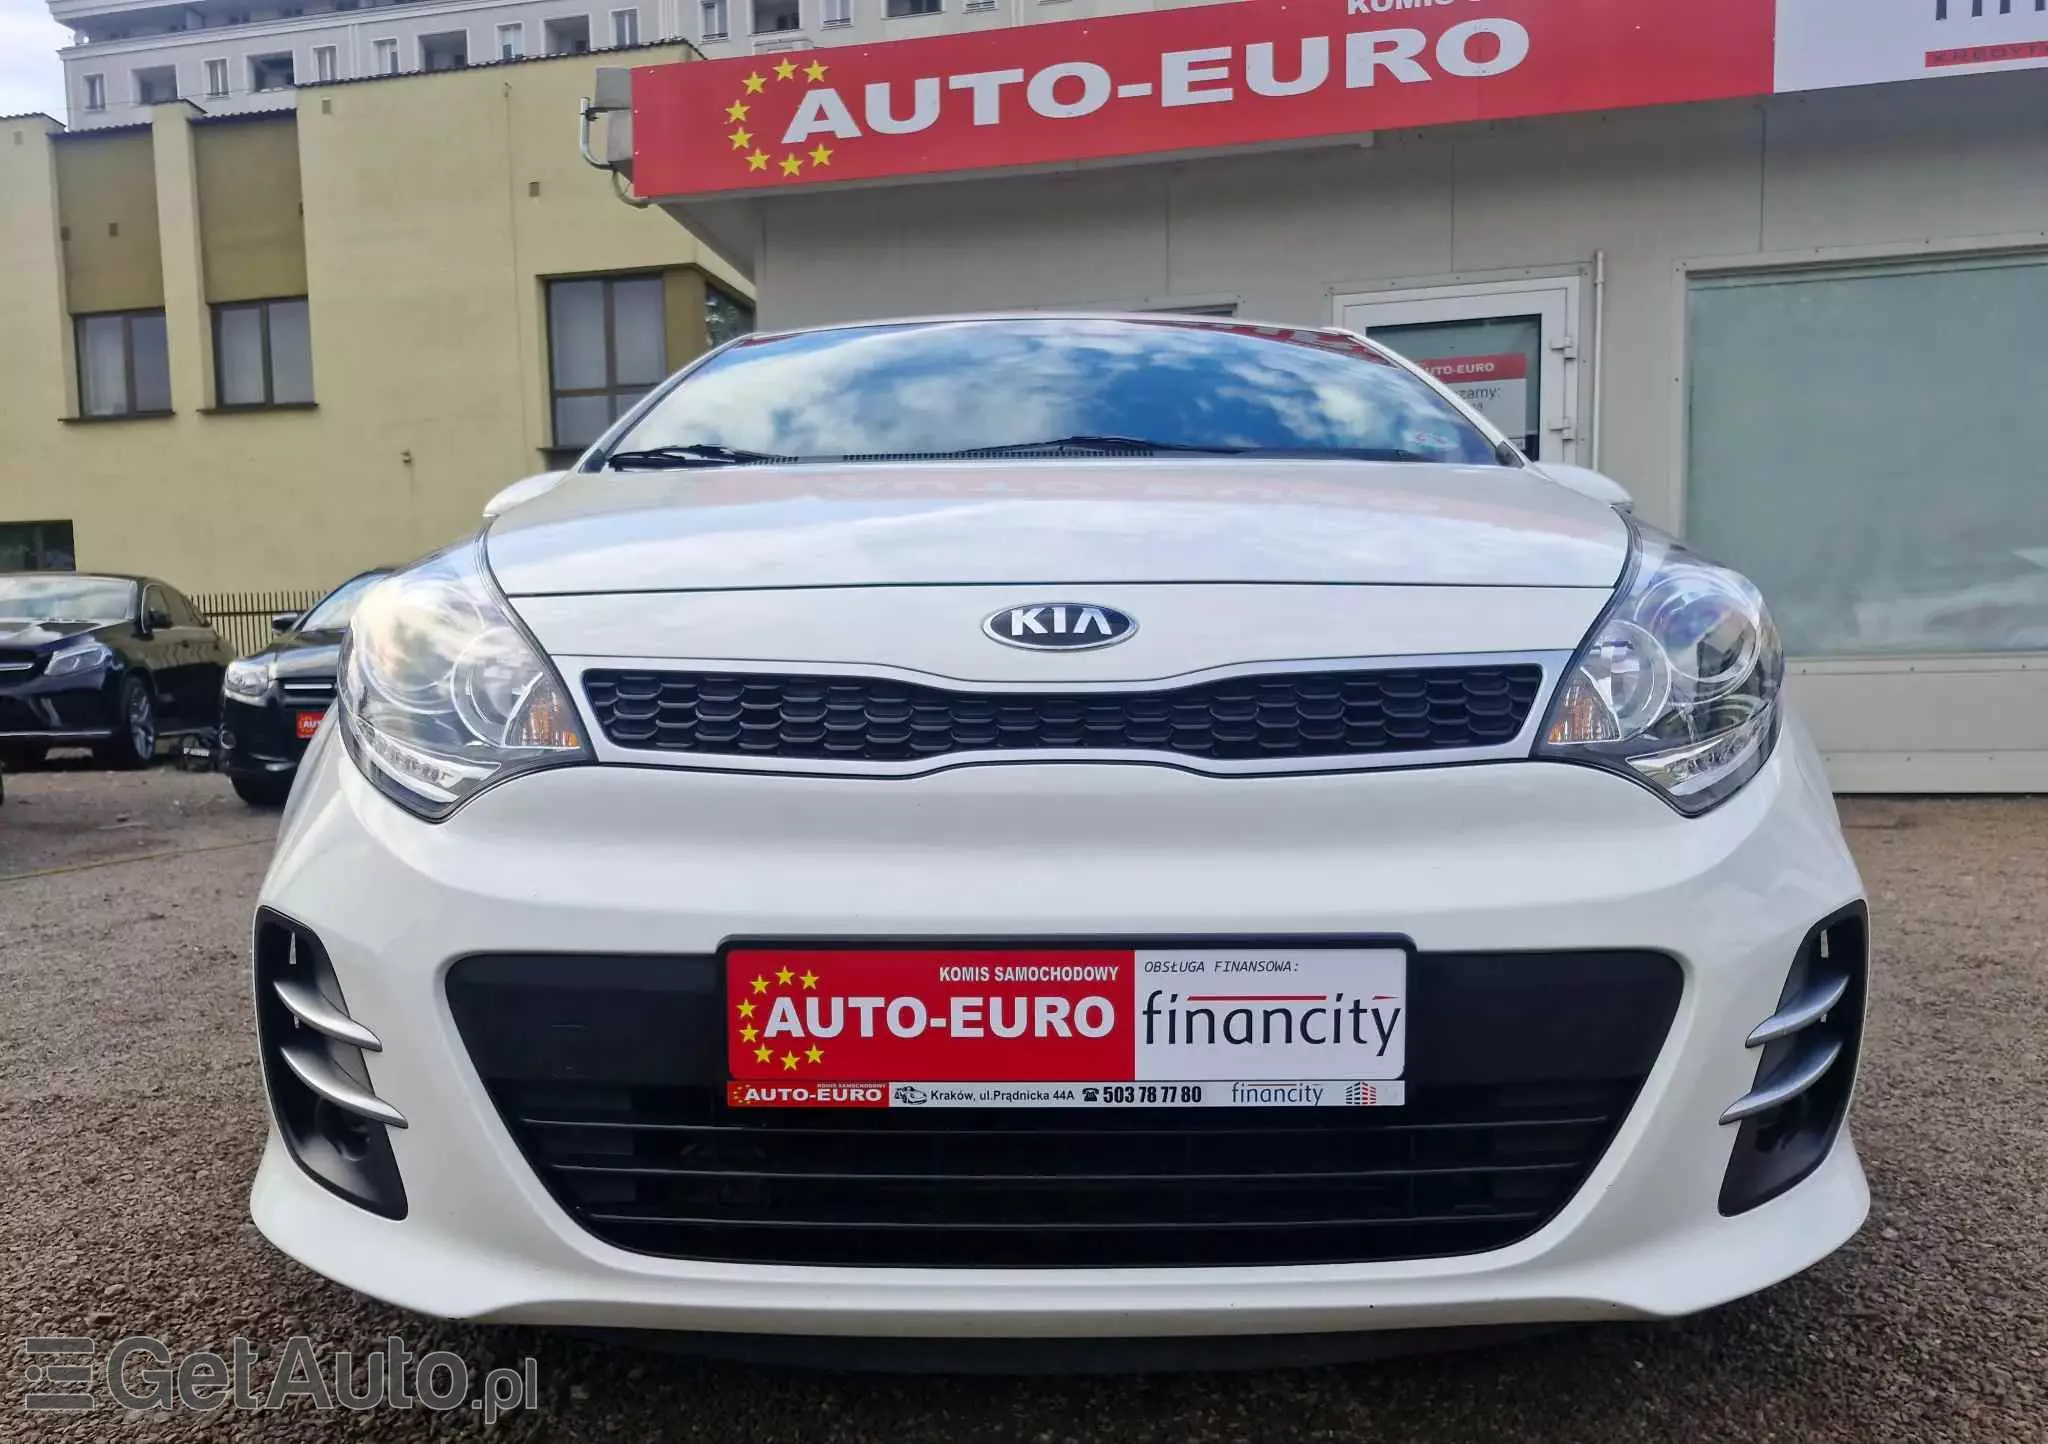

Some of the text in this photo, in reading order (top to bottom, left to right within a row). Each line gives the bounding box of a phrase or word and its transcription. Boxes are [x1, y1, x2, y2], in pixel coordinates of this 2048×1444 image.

[781, 18, 1529, 143] AUTO-EURO
[1426, 361, 1496, 376] UTO-EURO
[1011, 606, 1113, 636] KIA
[939, 965, 1119, 982] KOMIS SAMOCHODOWY
[1144, 960, 1299, 973] OBSŁUGA FINANSOWA:
[763, 996, 1115, 1038] AUTO-EURO
[1142, 989, 1401, 1057] financity
[744, 1087, 882, 1101] AUTO-EURO
[930, 1089, 976, 1103] Kraków,
[1053, 1090, 1075, 1101] 44A
[1103, 1086, 1135, 1104] 503
[1139, 1086, 1157, 1104] 78
[1160, 1086, 1178, 1104] 77
[1181, 1086, 1202, 1104] 80
[1232, 1082, 1323, 1106] financity
